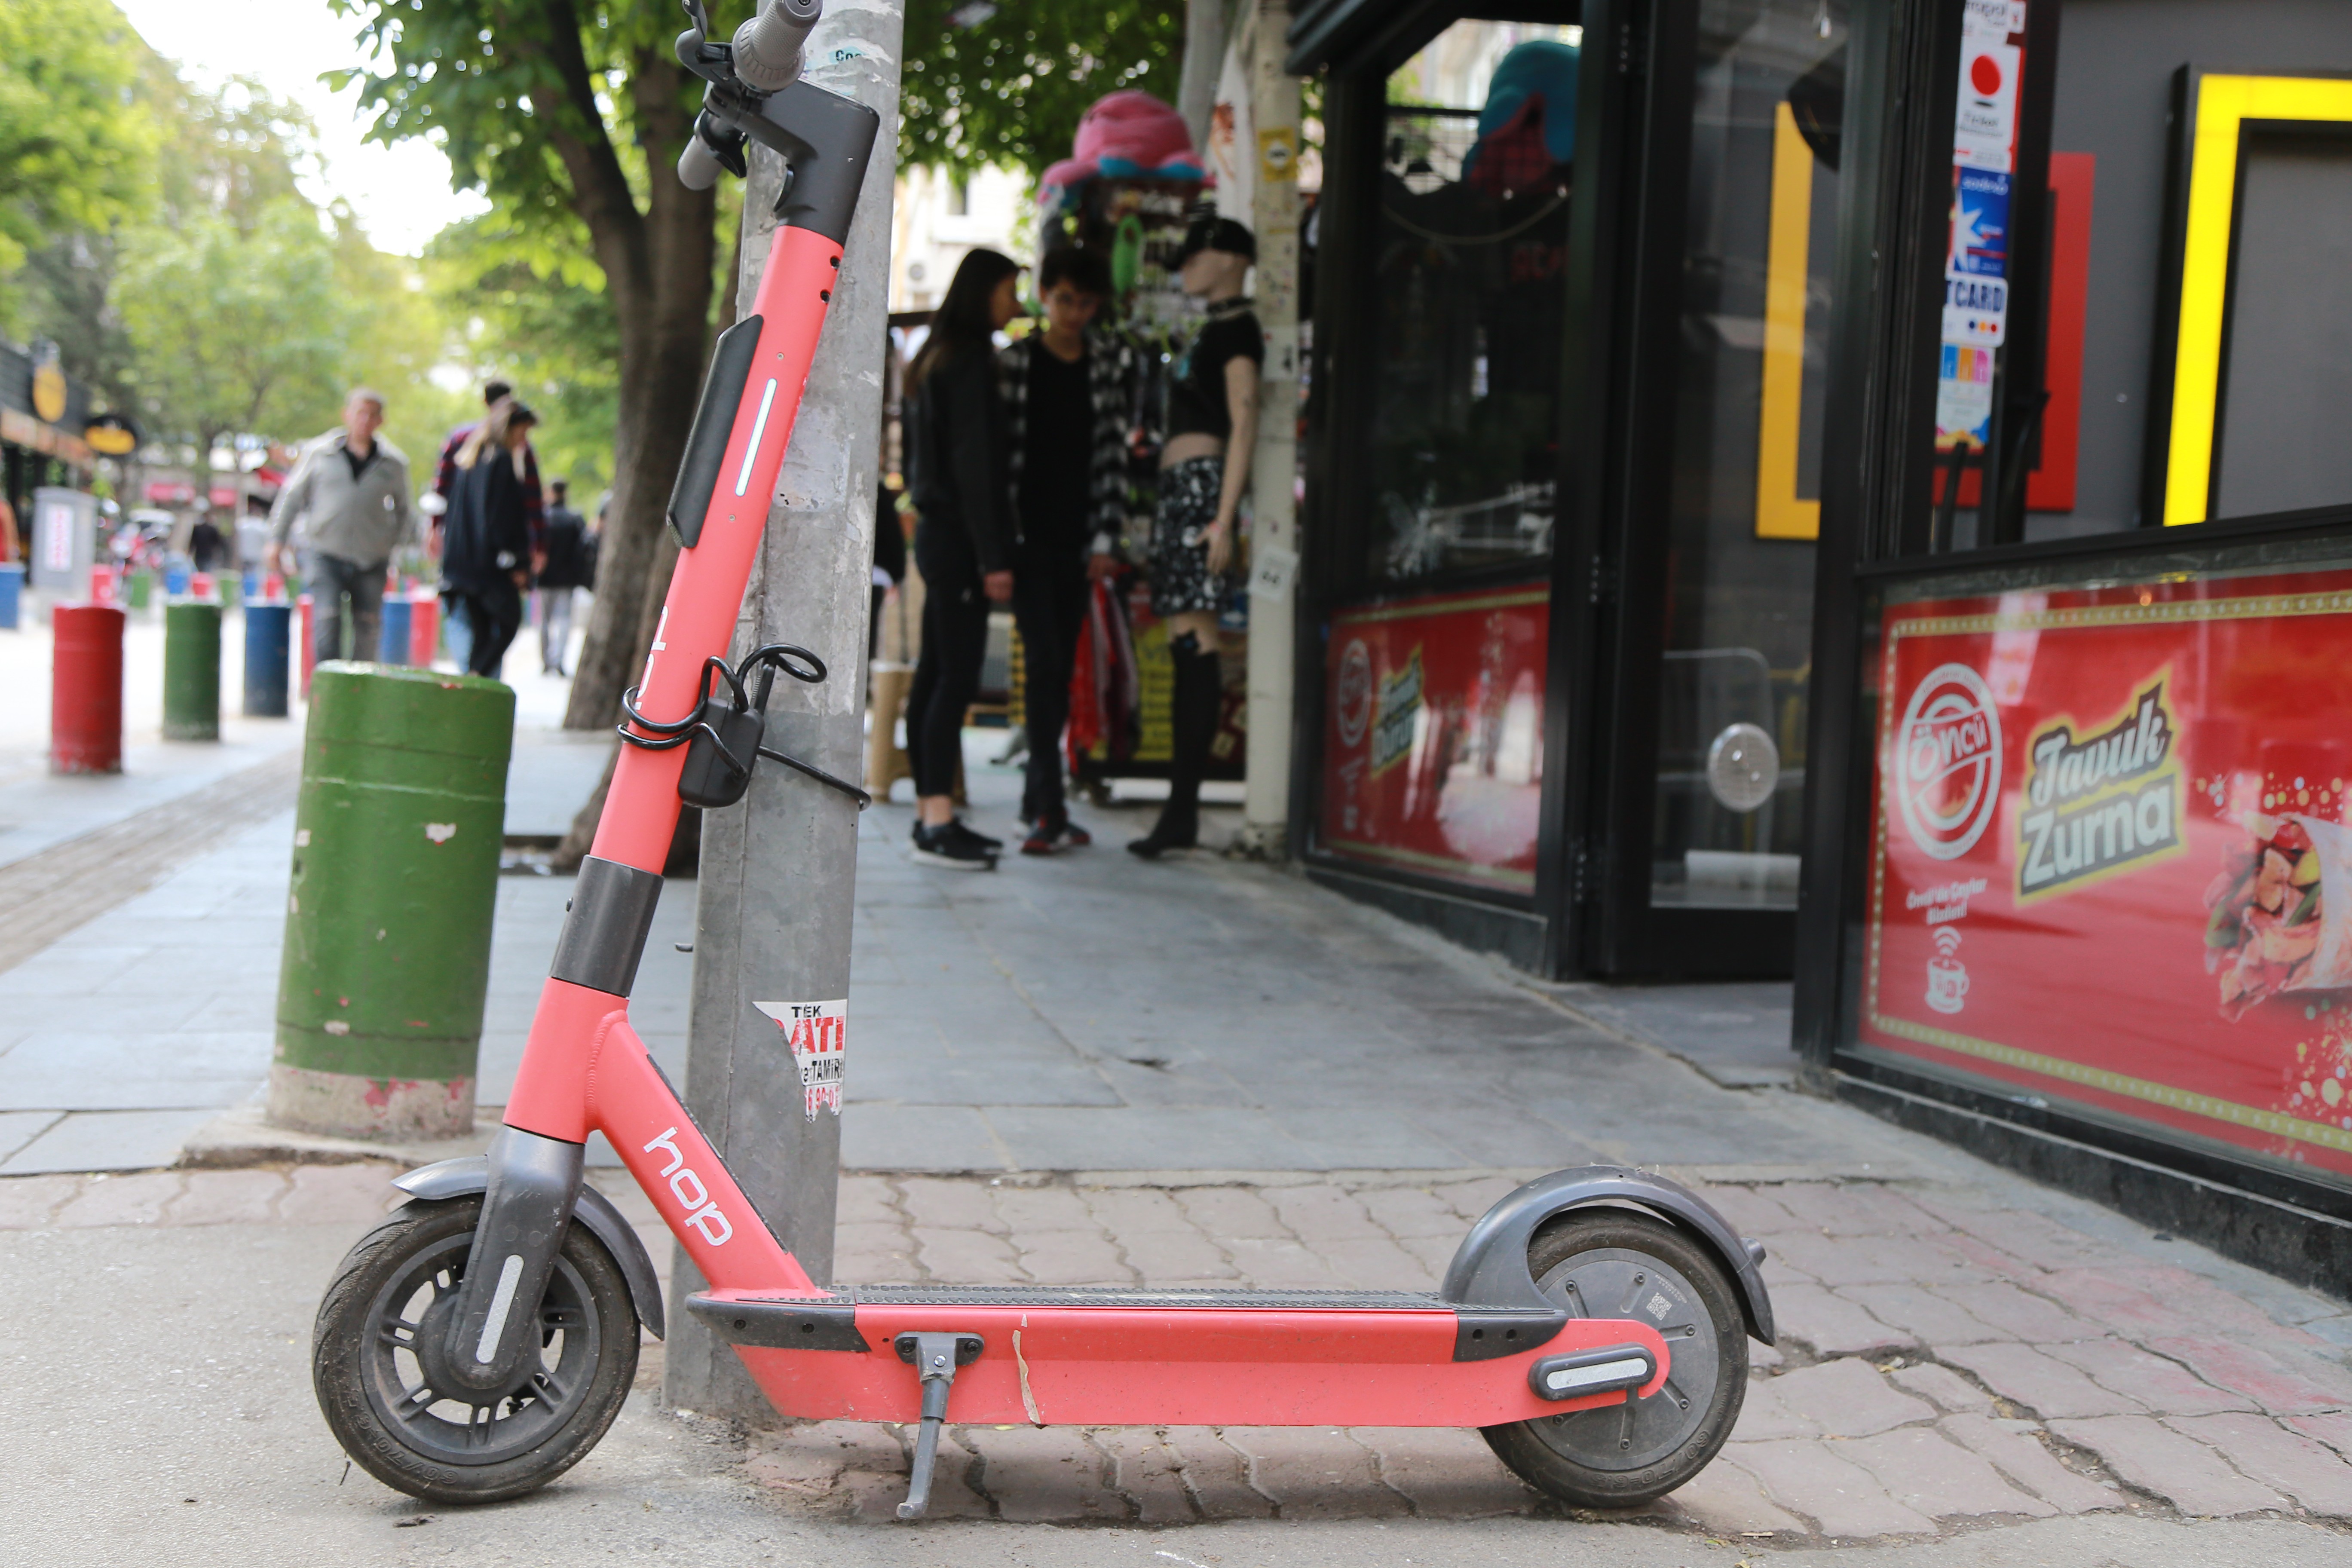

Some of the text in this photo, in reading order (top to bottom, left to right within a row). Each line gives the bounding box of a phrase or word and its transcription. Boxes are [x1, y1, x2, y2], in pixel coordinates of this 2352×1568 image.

[2030, 698, 2165, 807] Tavuk
[2023, 785, 2171, 887] Zurna
[791, 1005, 822, 1018] TEK
[643, 1127, 733, 1246] hop
